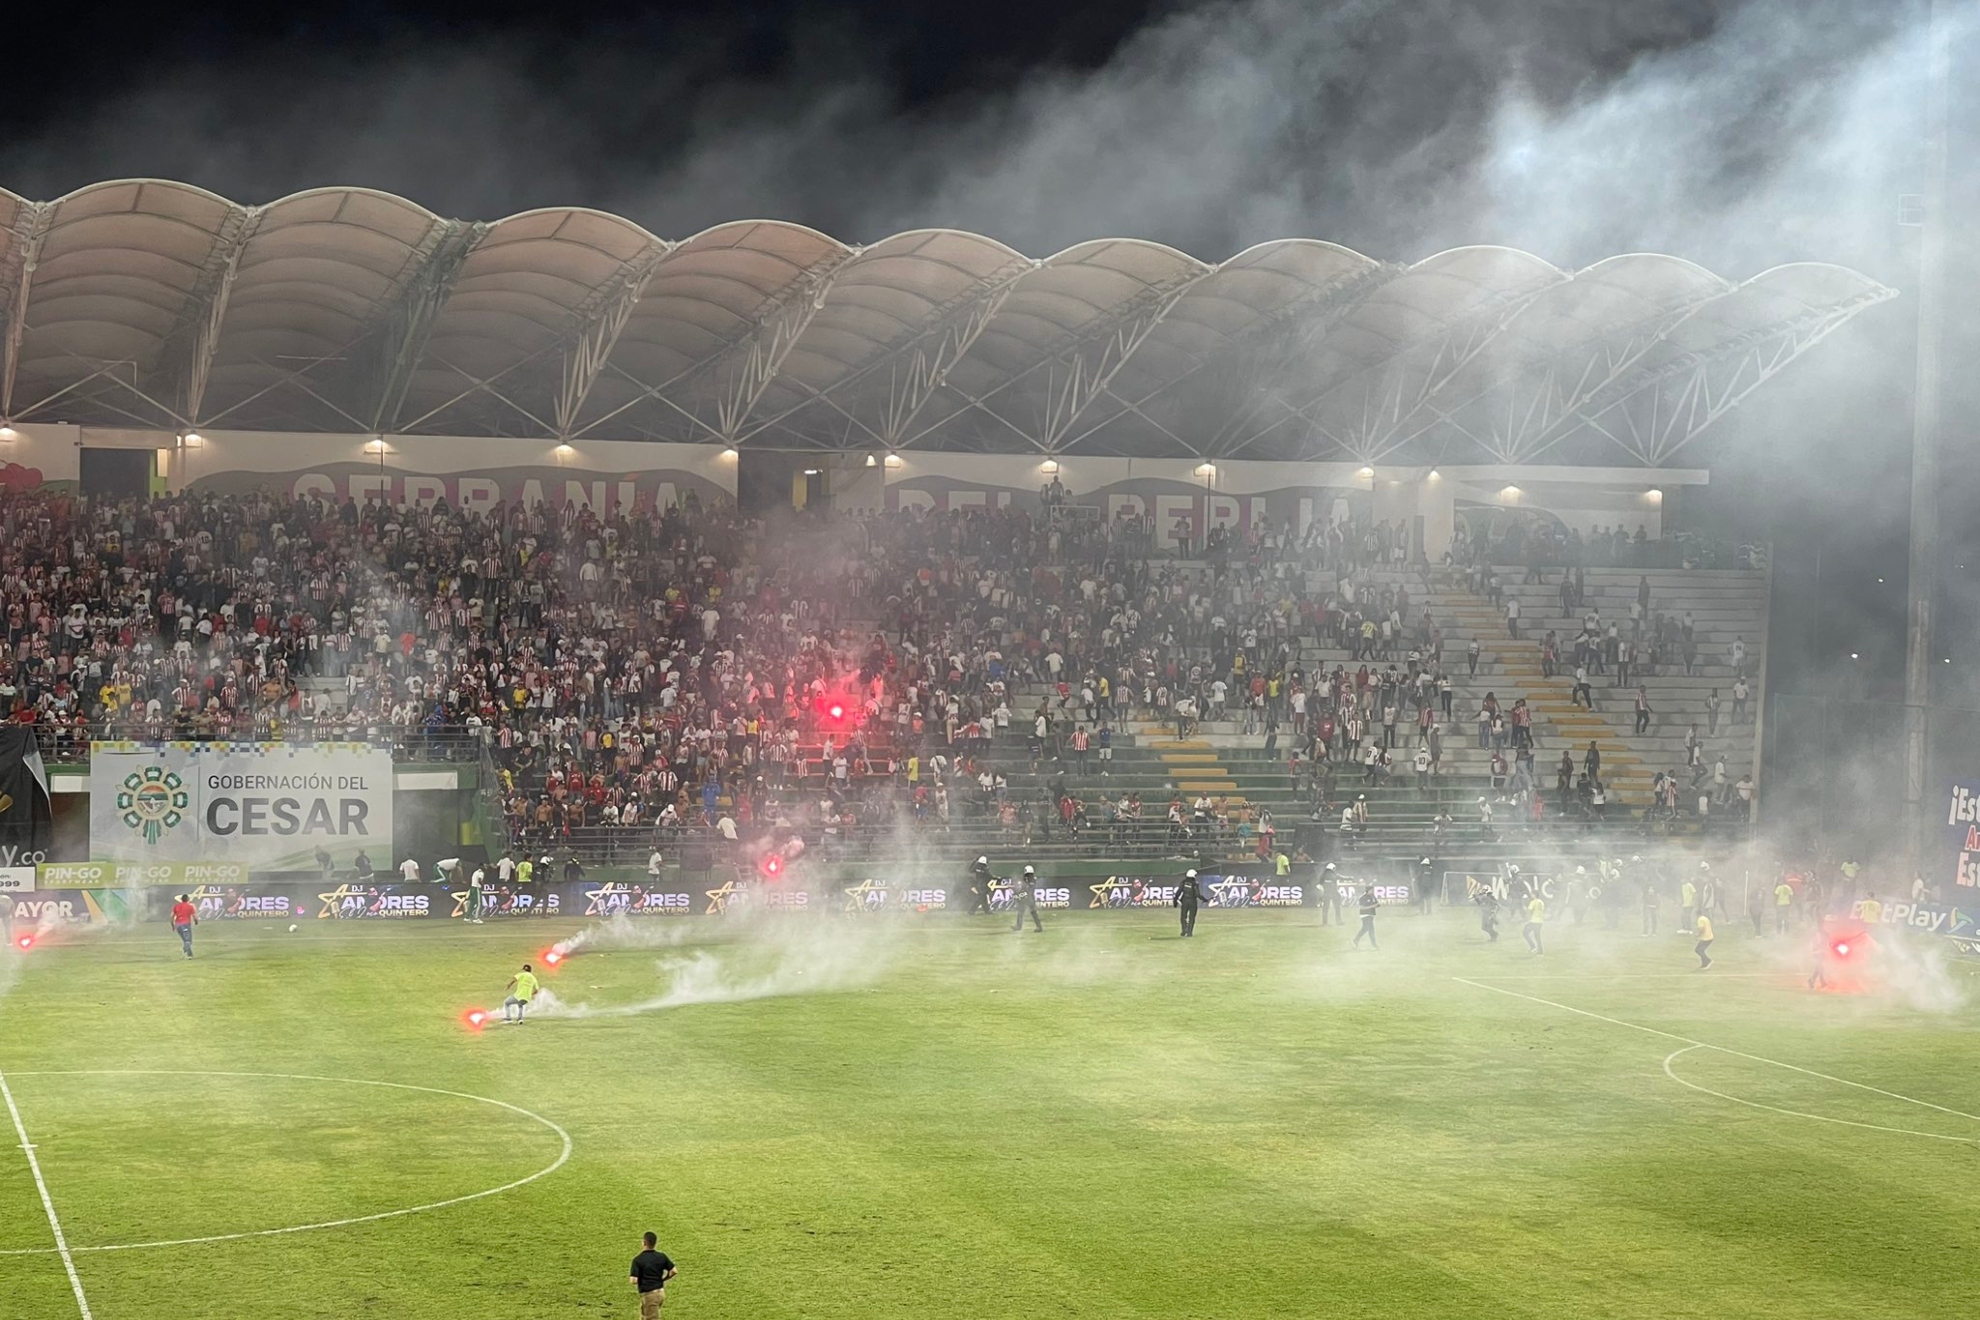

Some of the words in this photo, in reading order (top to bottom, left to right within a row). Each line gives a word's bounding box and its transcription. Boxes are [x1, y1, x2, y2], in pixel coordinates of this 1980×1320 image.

[208, 773, 332, 790] GOBERNACIÓN
[338, 776, 368, 790] DEL
[206, 797, 369, 836] CESAR
[44, 866, 102, 879] PIN-GO
[185, 865, 240, 877] PIN-GO
[727, 891, 808, 905] ANRES
[991, 888, 1070, 901] ANRES
[1338, 885, 1409, 899] ANRES
[481, 894, 560, 908] ANRS
[1142, 899, 1174, 907] QUINTE
[237, 910, 289, 918] QUINTERO
[379, 909, 429, 917] QUINTERO
[642, 906, 690, 914] QUINTERO
[1849, 900, 1947, 932] BtPlay
